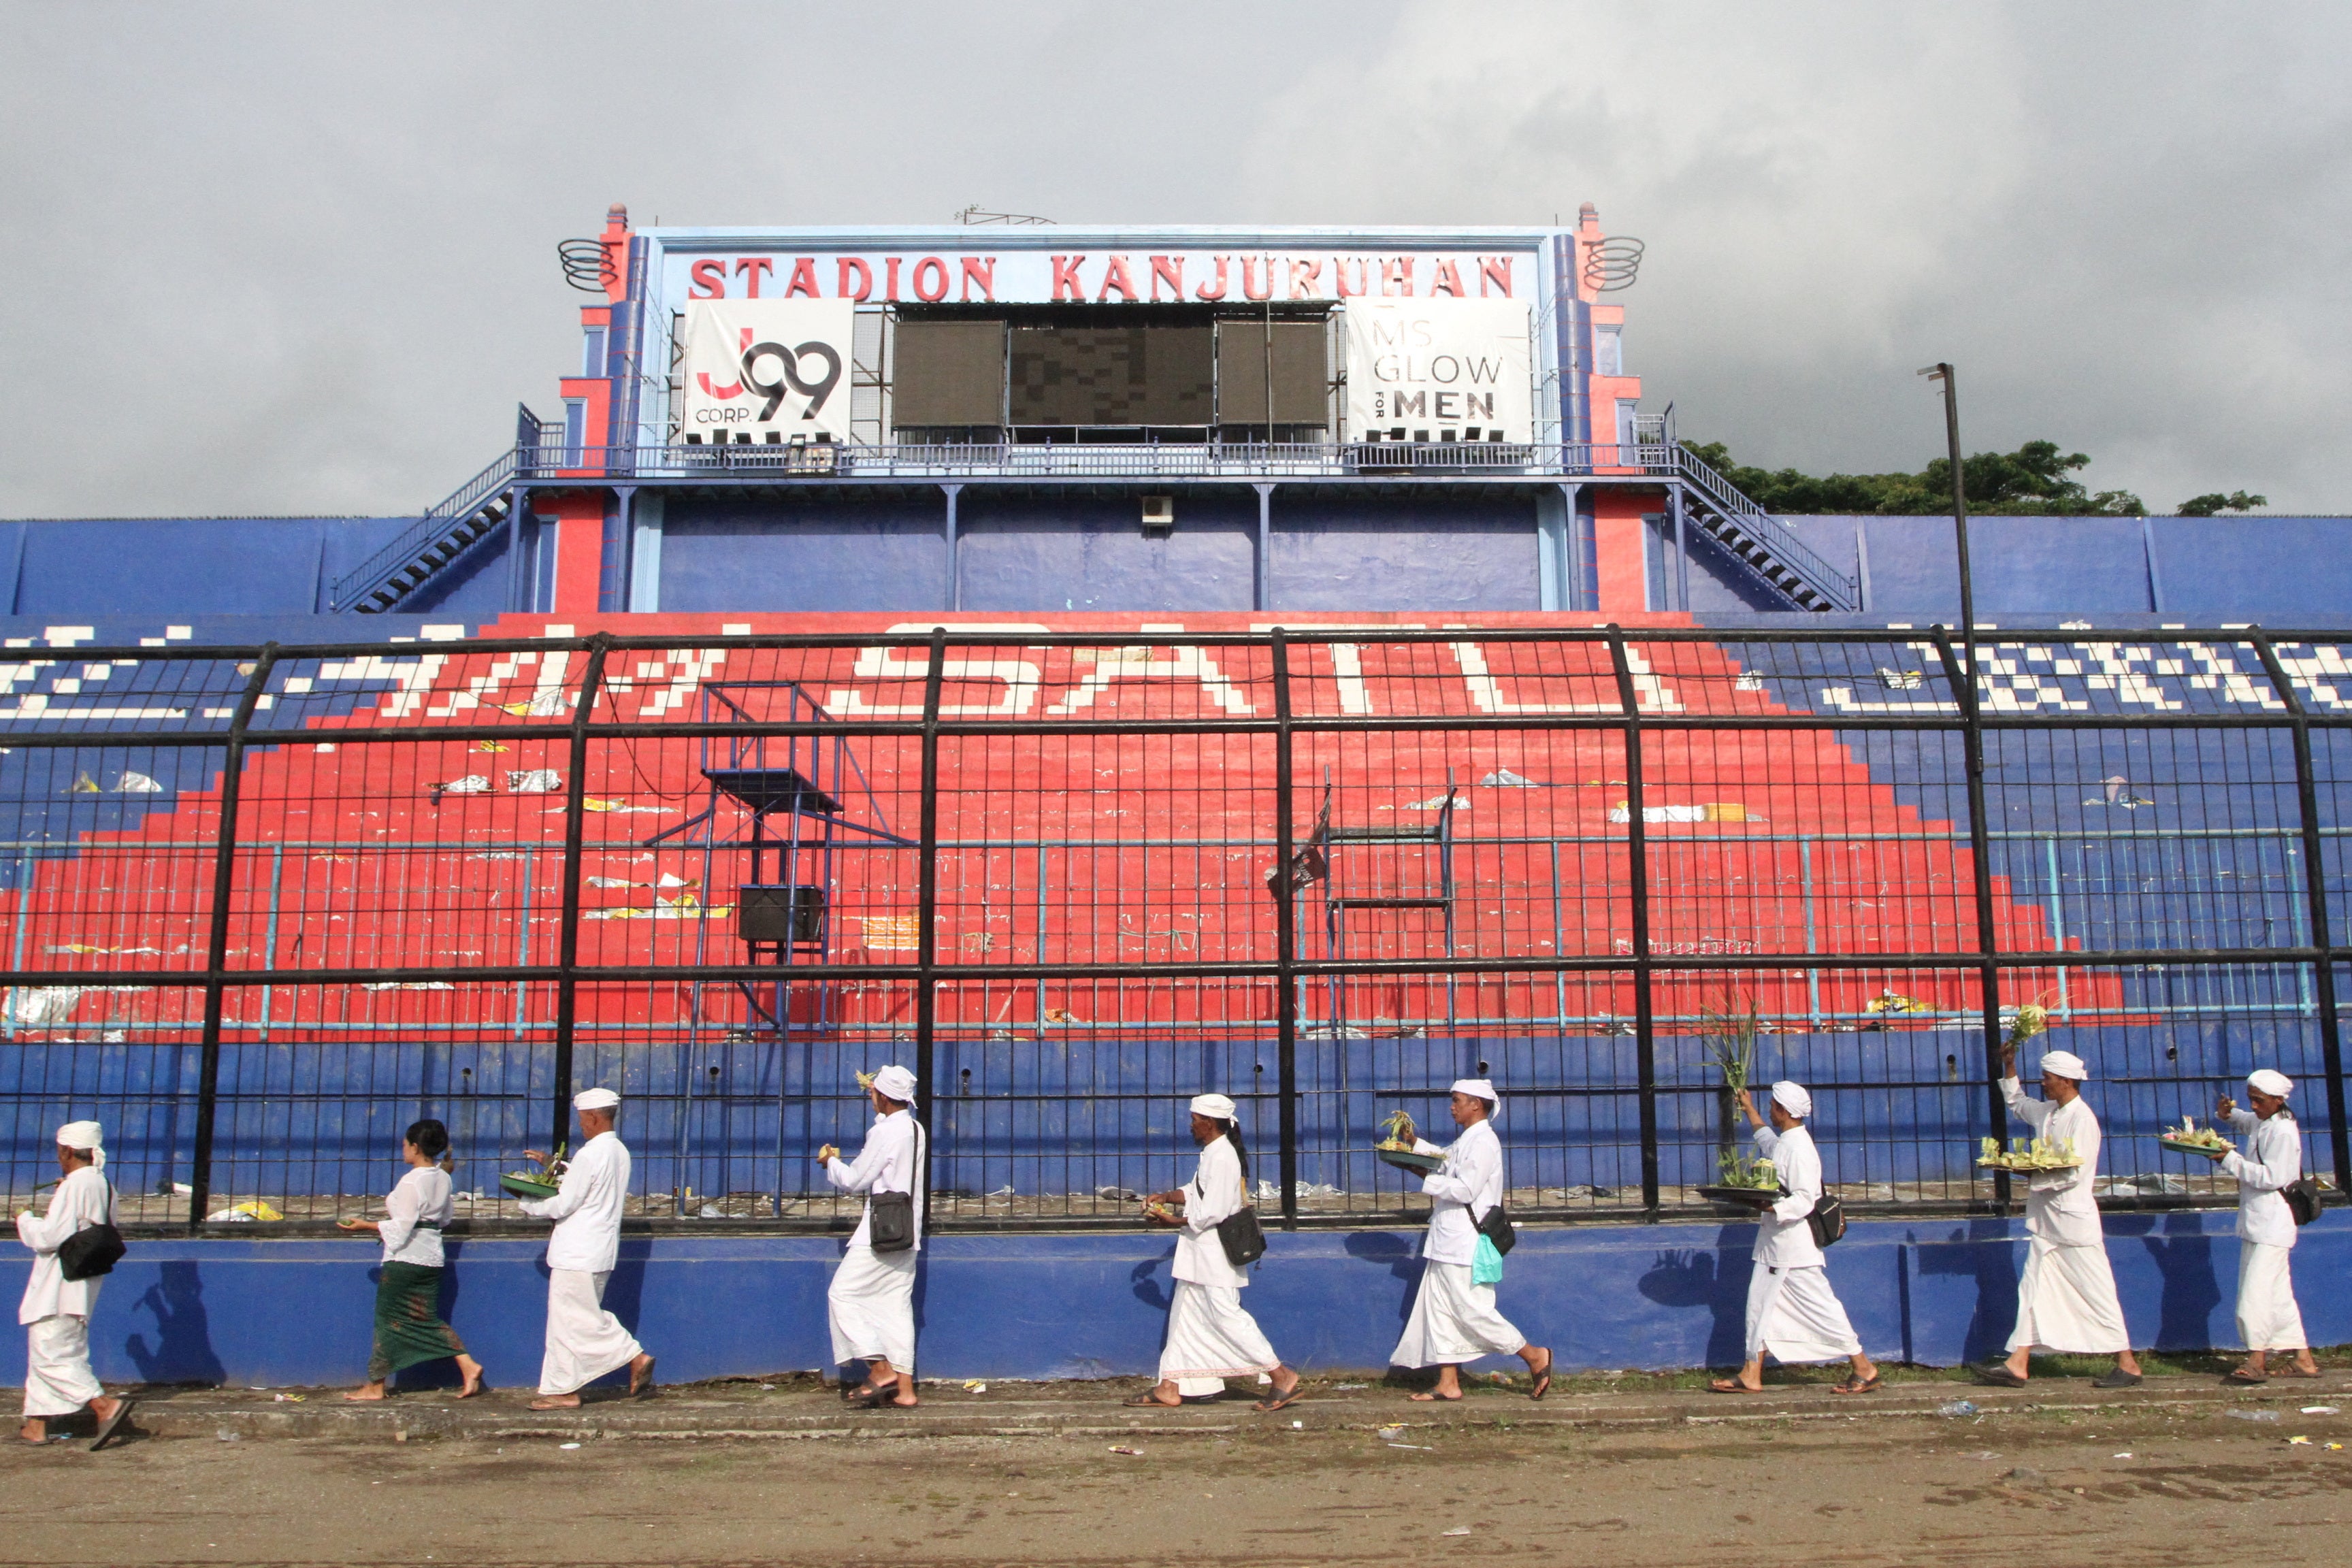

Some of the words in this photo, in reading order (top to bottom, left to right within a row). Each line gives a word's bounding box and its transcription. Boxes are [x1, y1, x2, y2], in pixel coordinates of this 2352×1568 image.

[689, 257, 996, 301] STADION
[1051, 255, 1513, 301] KANJURUHAN
[1373, 320, 1432, 346] MS
[1374, 355, 1503, 384] GLOW
[696, 408, 752, 423] CORP.
[1374, 392, 1384, 419] FOR
[1394, 391, 1494, 419] MEN
[823, 623, 1686, 715] SATU
